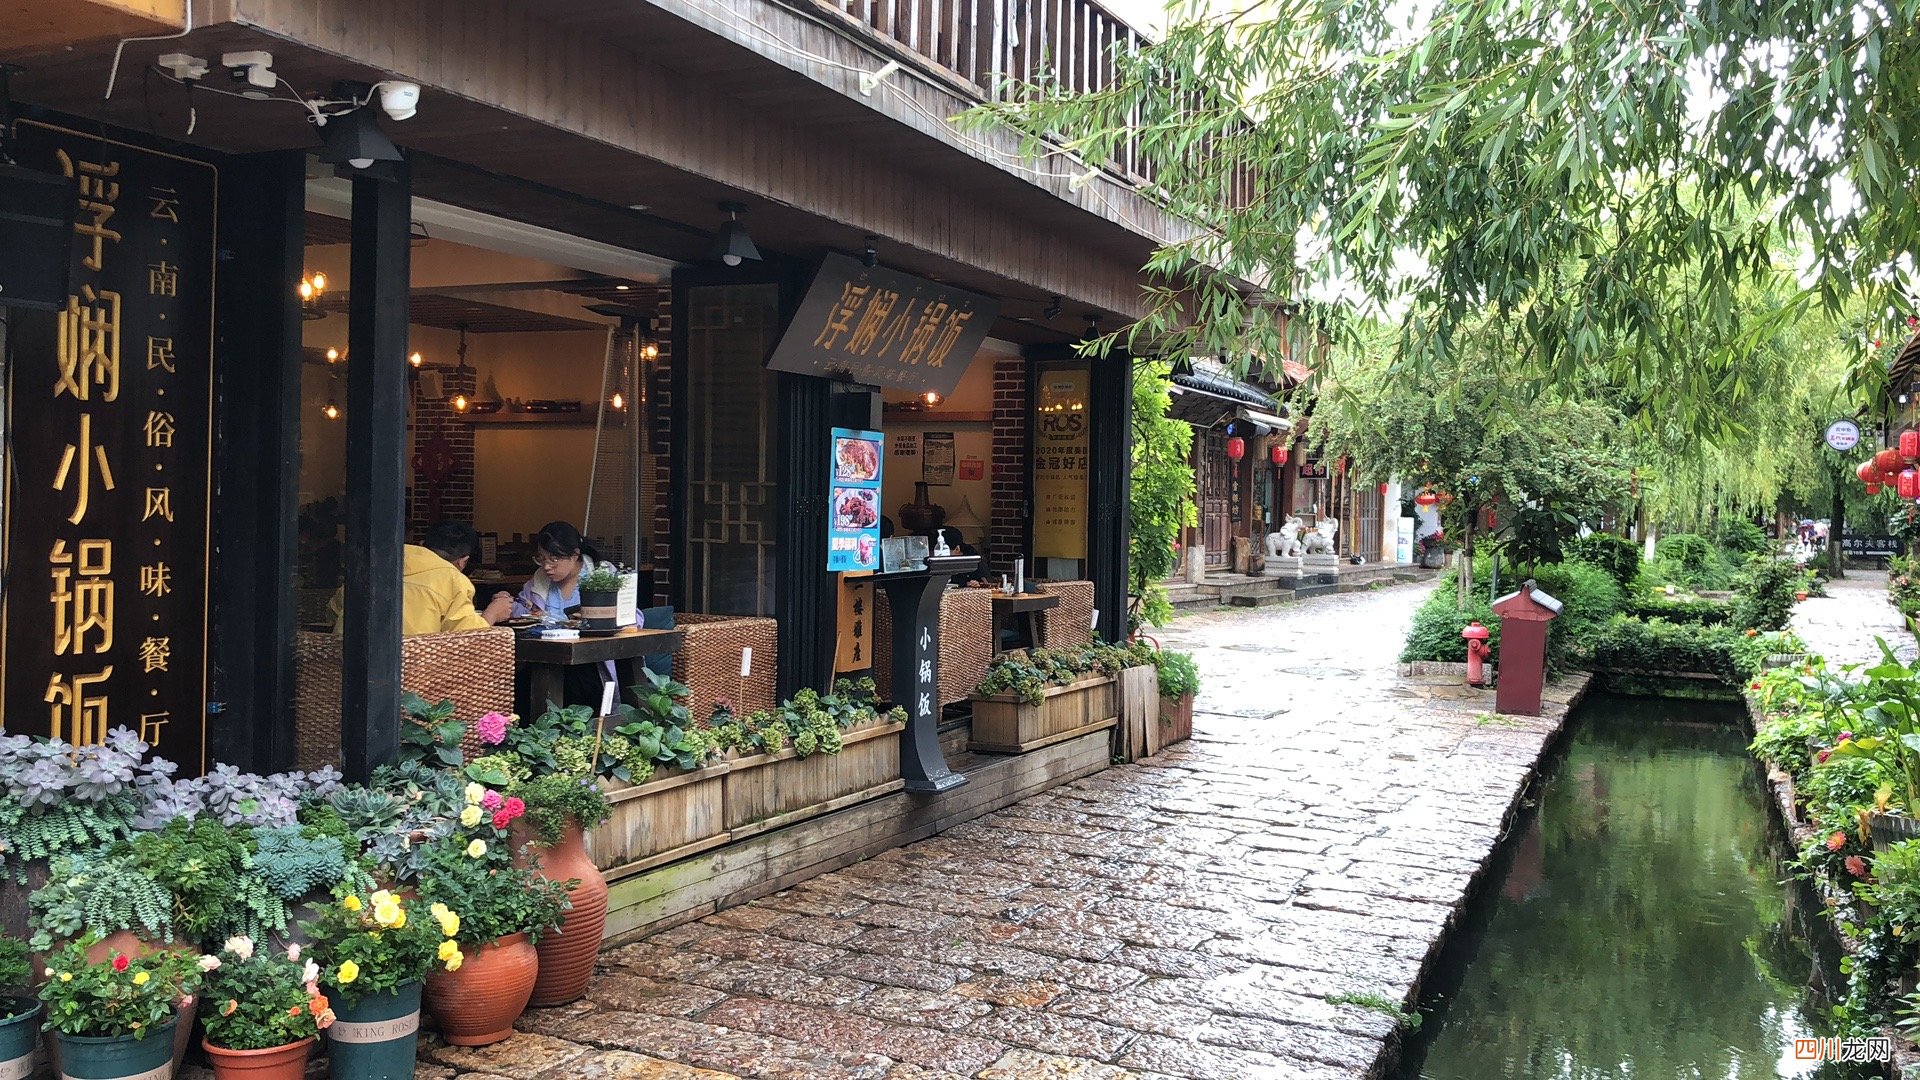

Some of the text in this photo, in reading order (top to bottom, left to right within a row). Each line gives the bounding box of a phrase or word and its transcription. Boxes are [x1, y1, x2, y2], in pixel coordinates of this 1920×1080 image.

[1043, 413, 1082, 431] ROS
[1036, 456, 1087, 470] 金冠好店
[918, 626, 932, 717] 小锅饭
